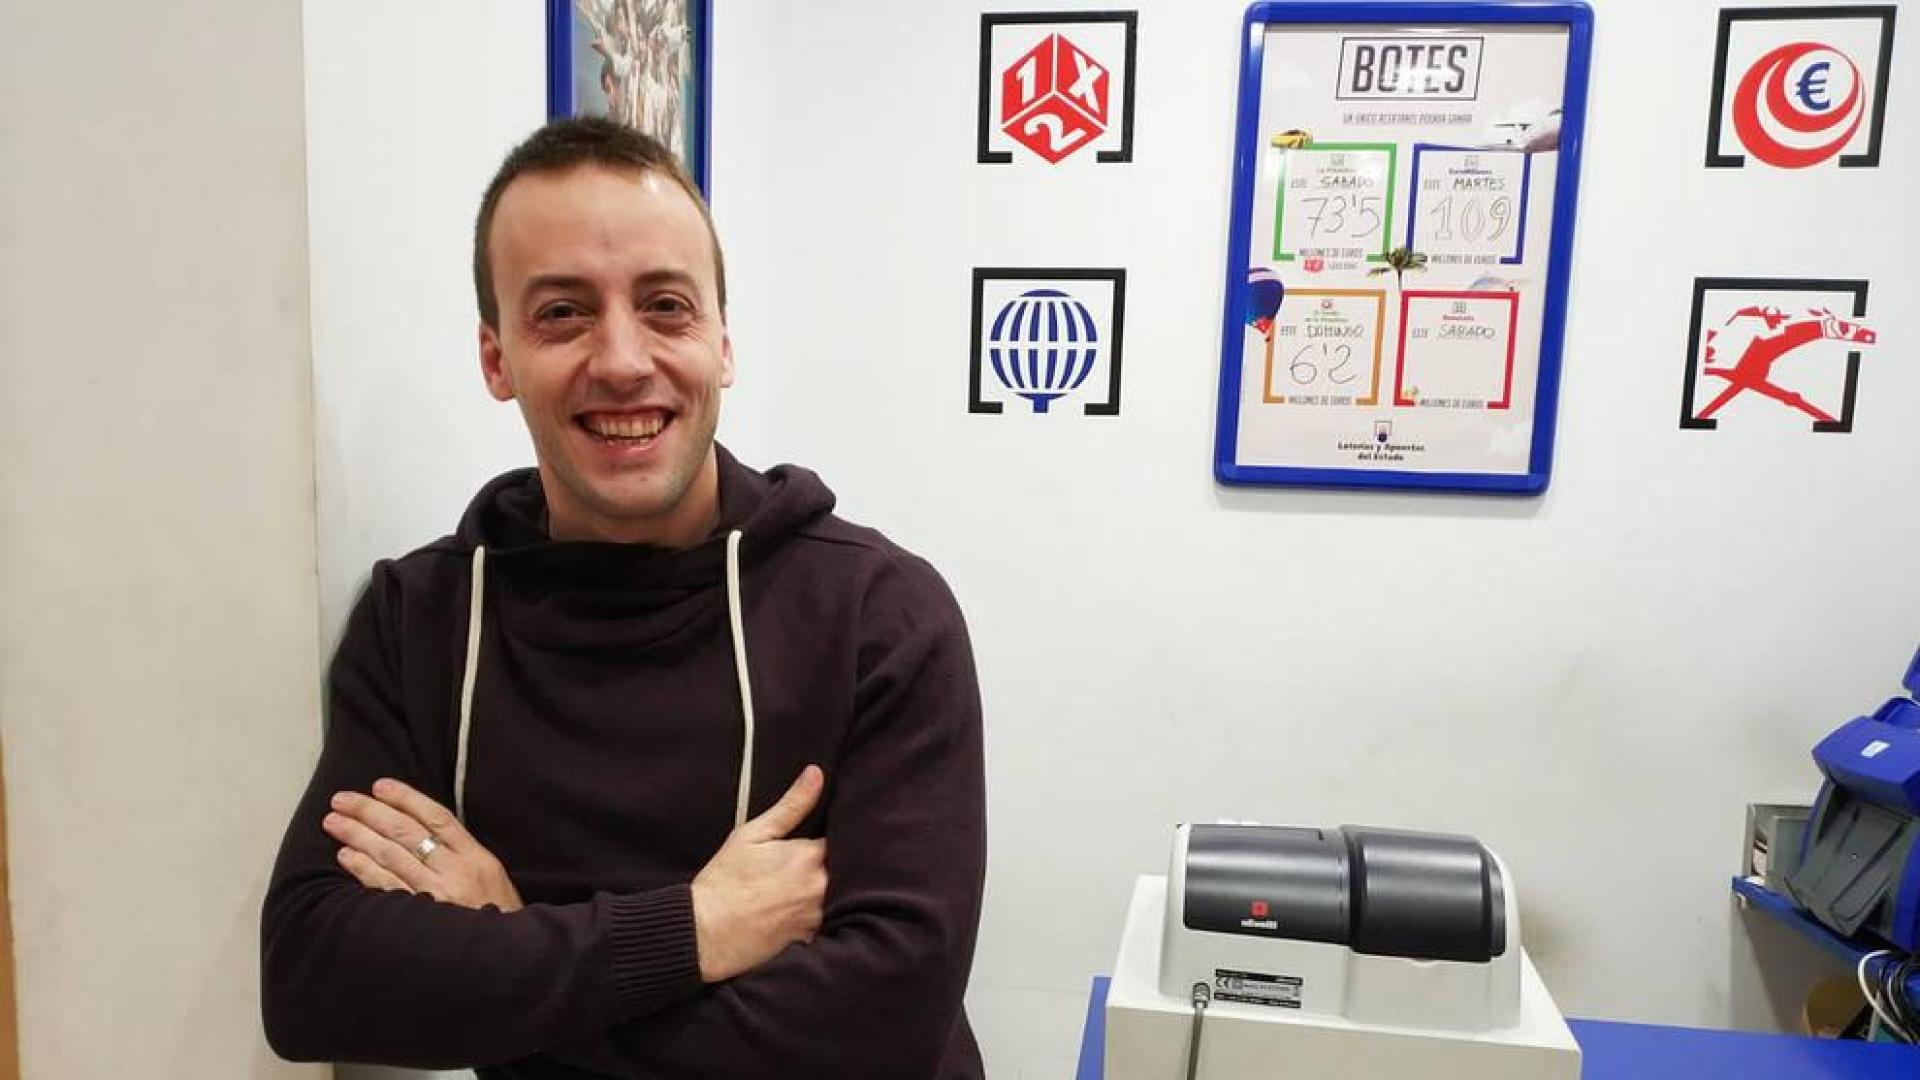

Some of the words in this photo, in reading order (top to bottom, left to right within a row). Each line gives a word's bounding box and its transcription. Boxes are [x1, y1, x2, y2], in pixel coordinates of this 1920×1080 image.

[1015, 55, 1036, 105] 1
[1352, 44, 1469, 93] BOTES
[1024, 113, 1087, 152] 2
[1453, 177, 1506, 191] MARTES
[1429, 195, 1512, 242] 109
